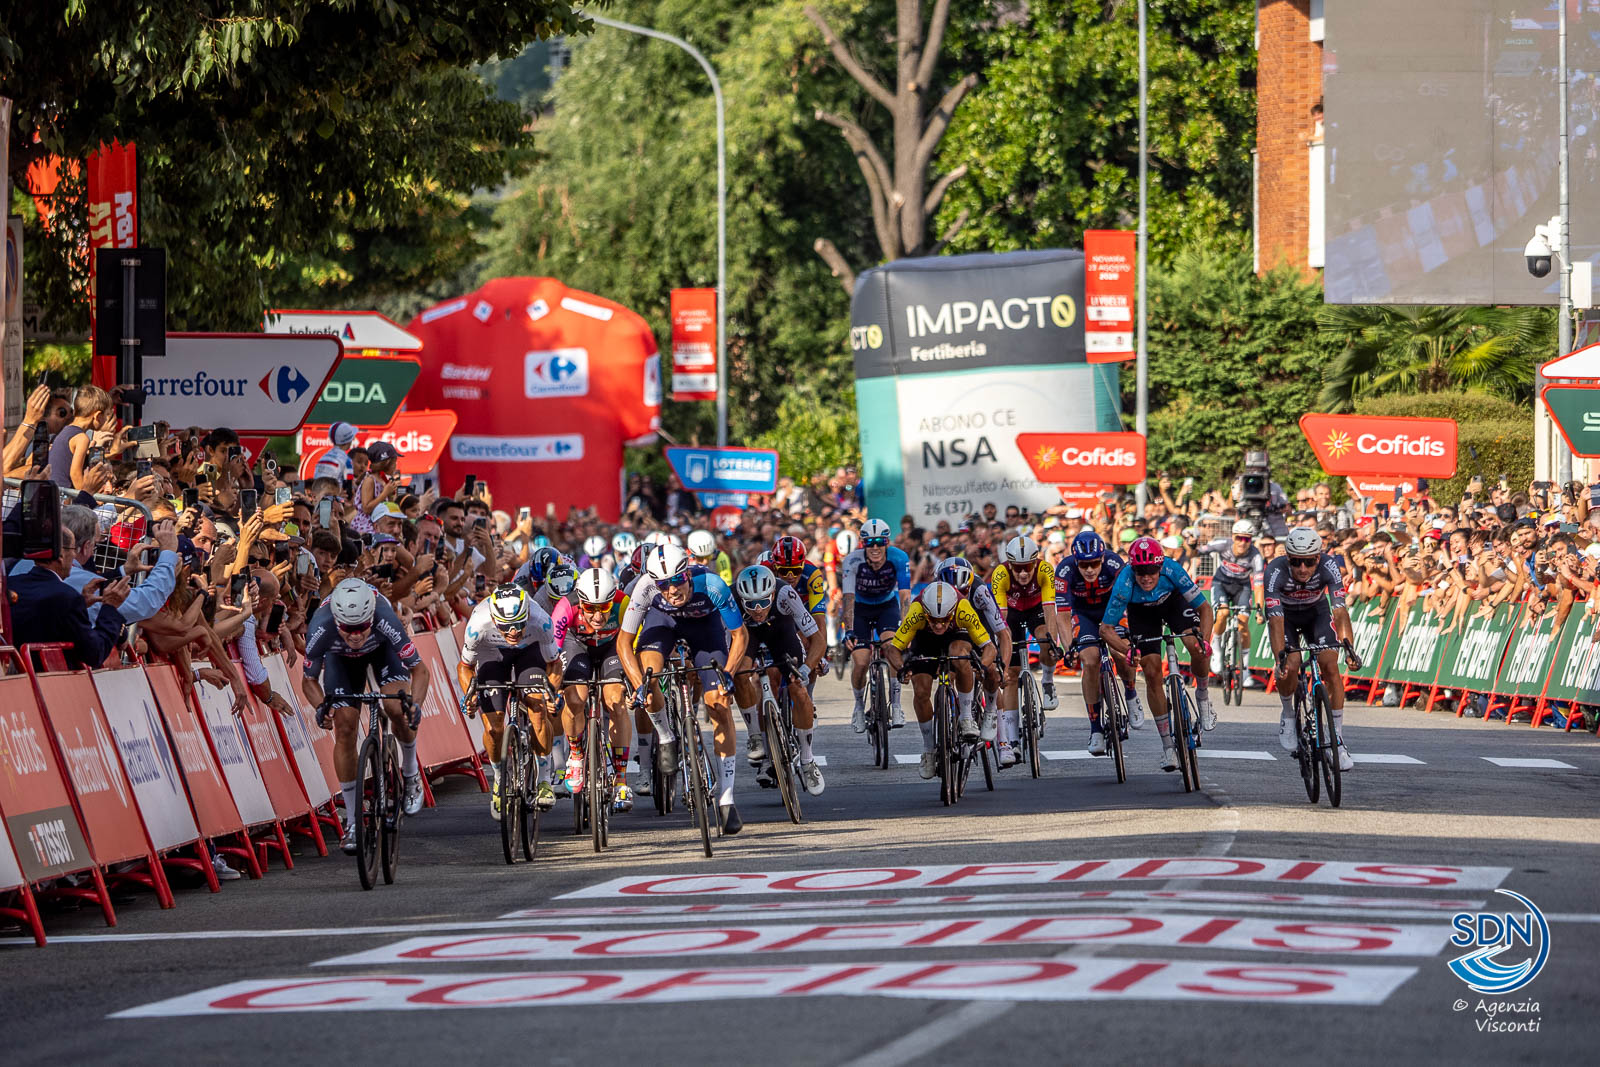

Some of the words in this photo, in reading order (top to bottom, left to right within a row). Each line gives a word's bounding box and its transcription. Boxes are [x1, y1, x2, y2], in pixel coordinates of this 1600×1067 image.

[910, 340, 987, 362] Fertiberia
[143, 370, 248, 397] arrefour
[318, 382, 387, 404] ODA
[919, 412, 986, 433] ABONO
[992, 409, 1016, 428] CE
[456, 442, 539, 458] Carrefour
[921, 436, 997, 469] NSA
[1061, 447, 1137, 467] Cofidis
[1357, 433, 1445, 457] Cofidis
[922, 480, 997, 497] Nitrosulfato
[924, 502, 942, 516] 26
[945, 500, 973, 517] (37)
[376, 618, 402, 646] Alpecin
[618, 857, 1464, 895] COFIDIS
[396, 915, 1402, 960] COFIDIS
[207, 960, 1348, 1011] COFIDIS
